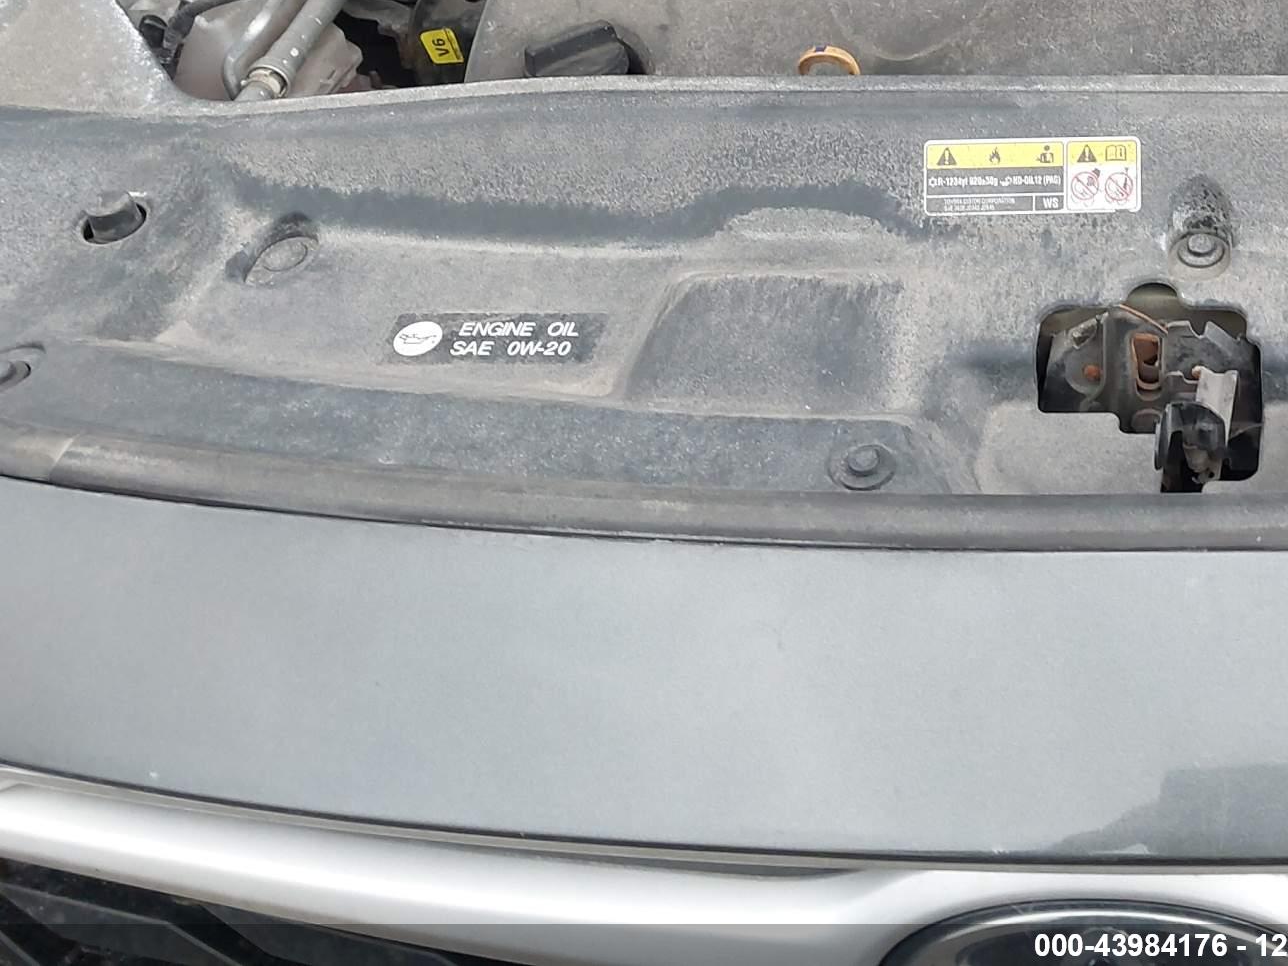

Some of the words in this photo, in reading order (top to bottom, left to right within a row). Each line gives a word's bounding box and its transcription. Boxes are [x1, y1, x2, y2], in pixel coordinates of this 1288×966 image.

[432, 38, 449, 57] V6
[1043, 197, 1059, 209] WS
[459, 321, 536, 337] ENGINE
[547, 321, 579, 337] OIL
[450, 341, 495, 356] SAE
[507, 341, 572, 356] 0W-20
